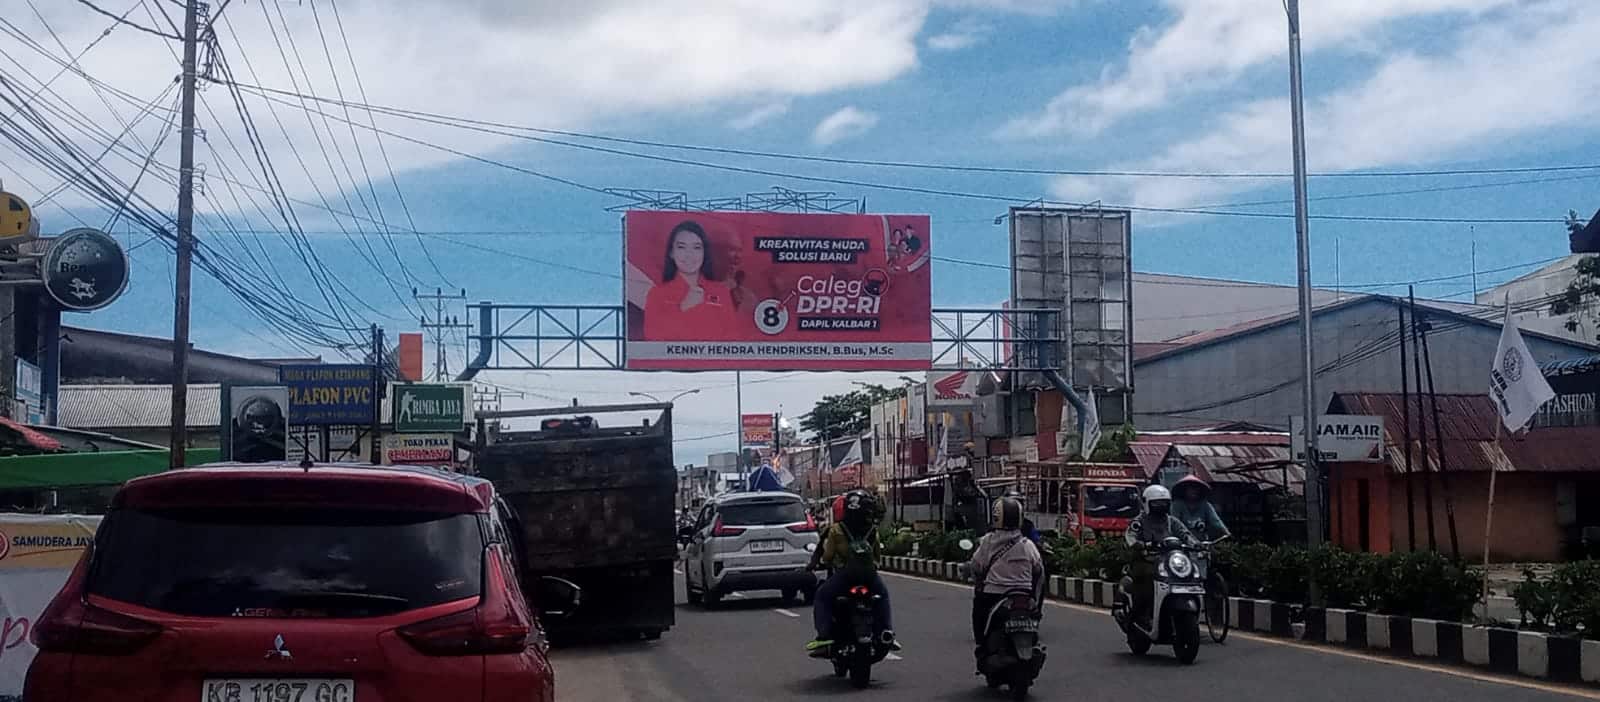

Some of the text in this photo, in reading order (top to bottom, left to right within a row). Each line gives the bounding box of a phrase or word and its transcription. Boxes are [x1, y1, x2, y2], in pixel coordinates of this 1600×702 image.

[758, 239, 866, 251] KREATIVITAS MUDA
[778, 251, 851, 262] SOLUSI BARU
[797, 275, 862, 298] Caleg
[796, 296, 881, 314] DPR-RI
[762, 306, 780, 328] 8
[801, 319, 878, 329] DAPIL KALBAR 1
[666, 345, 705, 356] KENNY
[708, 345, 754, 356] HENDRA
[757, 345, 830, 358] HENDRIKSEN,
[869, 346, 894, 356] M.Sc
[288, 386, 370, 405] PLAFON PVC
[412, 399, 461, 416] RIMBA JAYA
[1351, 424, 1380, 436] AIR
[403, 439, 424, 447] TOKO
[1088, 469, 1128, 477] HONDA
[12, 536, 72, 547] SAMUDERA
[207, 682, 348, 702] KB 1197 GC
